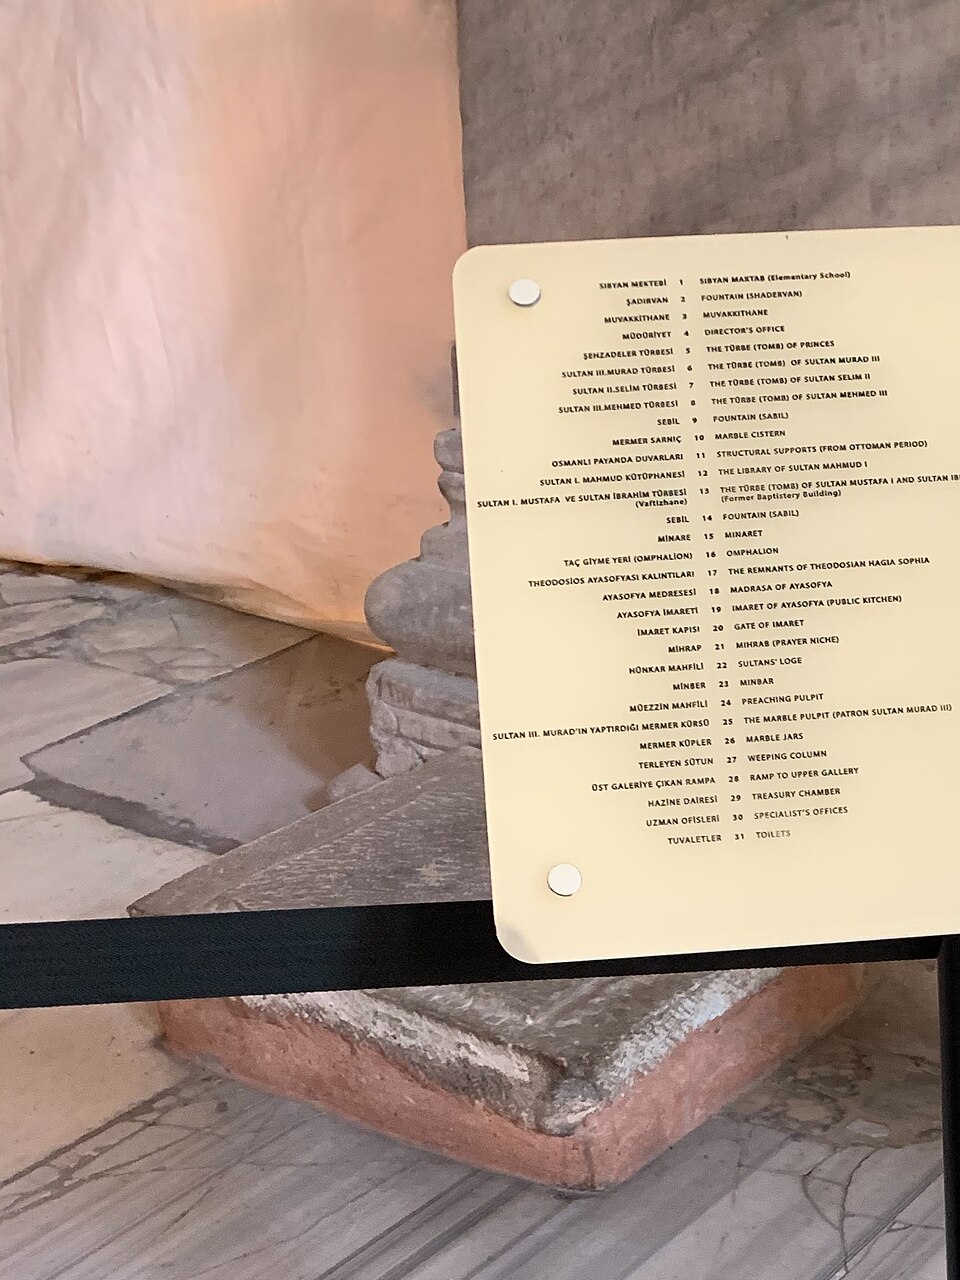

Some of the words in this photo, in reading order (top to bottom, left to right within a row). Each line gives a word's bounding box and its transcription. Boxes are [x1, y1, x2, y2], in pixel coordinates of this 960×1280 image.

[626, 296, 669, 307] ŞADIRVAN
[680, 295, 686, 303] 2
[700, 293, 744, 302] FOUNTAIN
[746, 290, 803, 300] (SHADERVAN)
[621, 330, 672, 340] MÜDÜRİYET
[704, 326, 754, 336] DIRECTOR'S
[755, 324, 785, 334] OFFICE
[611, 437, 648, 446] MERMER
[650, 435, 682, 444] SARNIÇ
[714, 431, 749, 440] MARBLE
[750, 429, 786, 438] CISTERN
[476, 499, 510, 508] SULTAN
[520, 496, 561, 505] MUSTAFA
[564, 495, 576, 503] VE
[578, 493, 611, 502] SULTAN
[612, 490, 651, 500] İBRAHİM
[650, 487, 687, 497] TÜRBESİ
[699, 487, 710, 495] 13
[719, 485, 737, 494] THE
[738, 484, 766, 493] TÜRBE
[767, 482, 799, 492] (TOMB)
[801, 481, 814, 489] OF
[814, 479, 847, 488] SULTAN
[849, 477, 889, 486] MUSTAFA
[896, 476, 915, 484] AND
[916, 474, 949, 483] SULTAN
[720, 495, 754, 503] (Former
[756, 492, 800, 502] Baptistery
[802, 489, 842, 498] Building)
[635, 497, 688, 508] (Vaftizhane)
[657, 533, 691, 543] MİNARE
[703, 532, 714, 540] 15
[724, 529, 763, 539] MINARET
[587, 573, 640, 584] AYASOFYASI
[641, 570, 695, 581] KALINTILARI
[727, 567, 745, 575] THE
[747, 564, 795, 574] REMNANTS
[796, 563, 808, 571] OF
[809, 560, 866, 570] THEODOSIAN
[868, 558, 896, 567] HAGIA
[897, 556, 930, 566] SOPHIA
[616, 609, 661, 619] AYASOFYA
[662, 606, 699, 616] İMARETİ
[731, 602, 764, 612] IMARET
[766, 602, 778, 610] OF
[780, 599, 825, 609] AYASOFYA
[826, 597, 860, 607] (PUBLIC
[862, 594, 902, 604] KITCHEN)
[637, 627, 670, 636] İMARET
[671, 625, 700, 634] KAPISI
[712, 624, 724, 632] 20
[733, 621, 756, 631] GATE
[757, 621, 770, 629] OF
[772, 619, 805, 628] IMARET
[667, 644, 702, 653] MİHRAP
[714, 643, 724, 651] 21
[735, 639, 770, 649] MIHRAB
[771, 637, 808, 648] (PRAYER
[809, 635, 839, 644] NICHE)
[628, 665, 666, 675] HÜNKAR
[667, 661, 704, 672] MAHFİLİ
[716, 661, 727, 669] 22
[778, 656, 802, 665] LOGE
[672, 681, 706, 690] MİNBER
[718, 680, 729, 688] 23
[739, 677, 774, 686] MINBAR
[628, 702, 669, 712] MÜEZZİN
[671, 699, 708, 710] MAHFİLİ
[720, 699, 731, 707] 24
[741, 695, 792, 705] PREACHING
[793, 692, 824, 702] PULPIT
[492, 731, 526, 741] SULTAN
[528, 730, 540, 738] III.
[542, 727, 588, 737] MURAD'IN
[641, 721, 679, 731] MERMER
[680, 718, 710, 728] KÜRSÜ
[721, 718, 733, 726] 25
[743, 715, 761, 724] THE
[762, 713, 797, 723] MARBLE
[799, 711, 830, 721] PULPIT
[831, 709, 869, 719] (PATRON
[871, 706, 904, 716] SULTAN
[906, 704, 938, 714] MURAD
[939, 703, 952, 711] III)
[639, 740, 677, 750] MERMER
[678, 738, 712, 747] KÜPLER
[724, 736, 736, 745] 26
[745, 733, 781, 743] MARBLE
[782, 732, 804, 741] JARS
[637, 759, 682, 769] TERLEYEN
[683, 757, 714, 767] SÜTUN
[726, 755, 737, 764] 27
[746, 752, 788, 762] WEEPING
[789, 749, 827, 760] COLUMN
[591, 783, 609, 792] ÜST
[610, 780, 653, 791] GALERİYE
[655, 778, 683, 789] ÇIKAN
[684, 776, 716, 785] RAMPA
[727, 775, 739, 783] 28
[749, 772, 774, 781] RAMP
[775, 771, 788, 779] TO
[790, 769, 819, 779] UPPER
[820, 766, 859, 777] GALLERY
[647, 797, 681, 807] HAZİNE
[683, 794, 718, 805] DAİRESİ
[730, 794, 741, 802] 29
[751, 790, 796, 800] TREASURY
[798, 787, 841, 797] CHAMBER
[645, 817, 679, 827] UZMAN
[680, 814, 720, 825] OFİSLERİ
[732, 813, 743, 821] 30
[753, 808, 810, 820] SPECIALIST'S
[812, 805, 848, 816] OFFICES
[666, 834, 722, 845] TUVALETLER
[734, 833, 744, 841] 31
[755, 829, 791, 839] TOILETS
